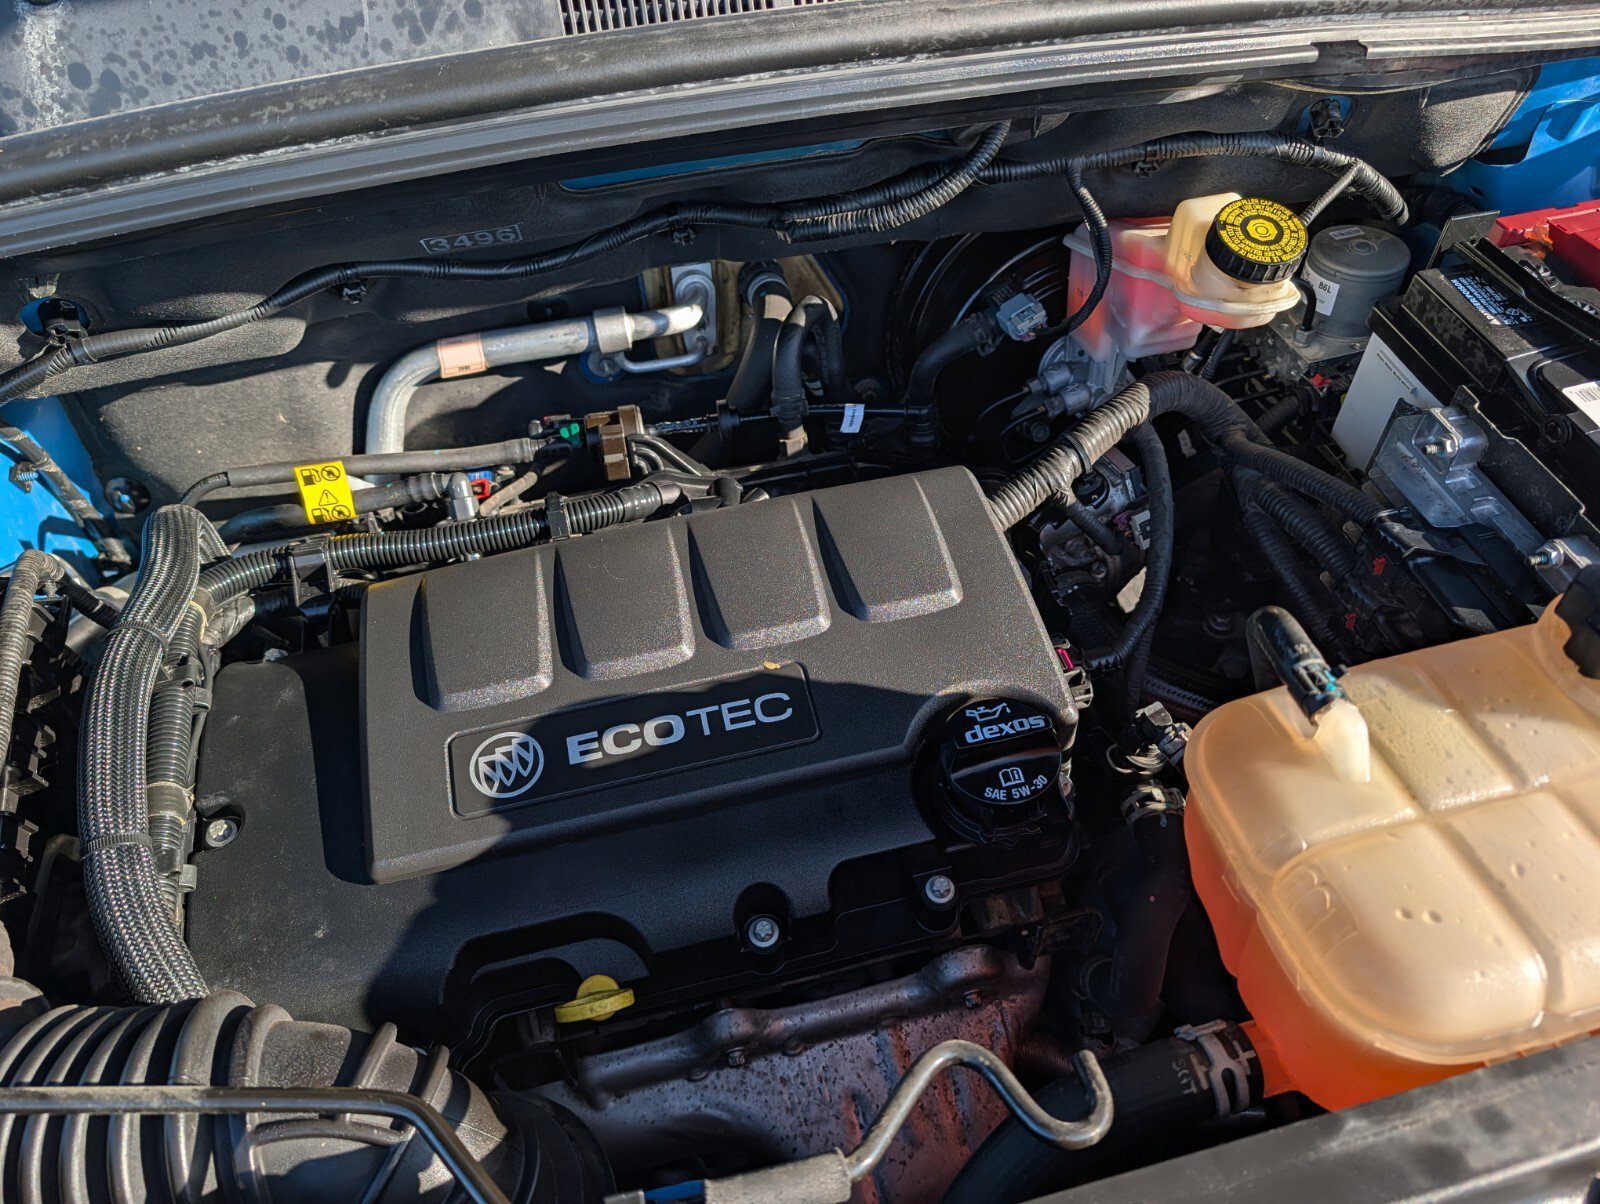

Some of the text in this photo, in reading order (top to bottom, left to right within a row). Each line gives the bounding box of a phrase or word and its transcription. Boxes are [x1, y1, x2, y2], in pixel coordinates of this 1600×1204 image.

[429, 228, 516, 251] 3496
[1318, 281, 1332, 294] B6L
[566, 692, 793, 765] ECOTEC
[964, 715, 1046, 744] dexos
[984, 774, 1048, 801] SAE 5W-30
